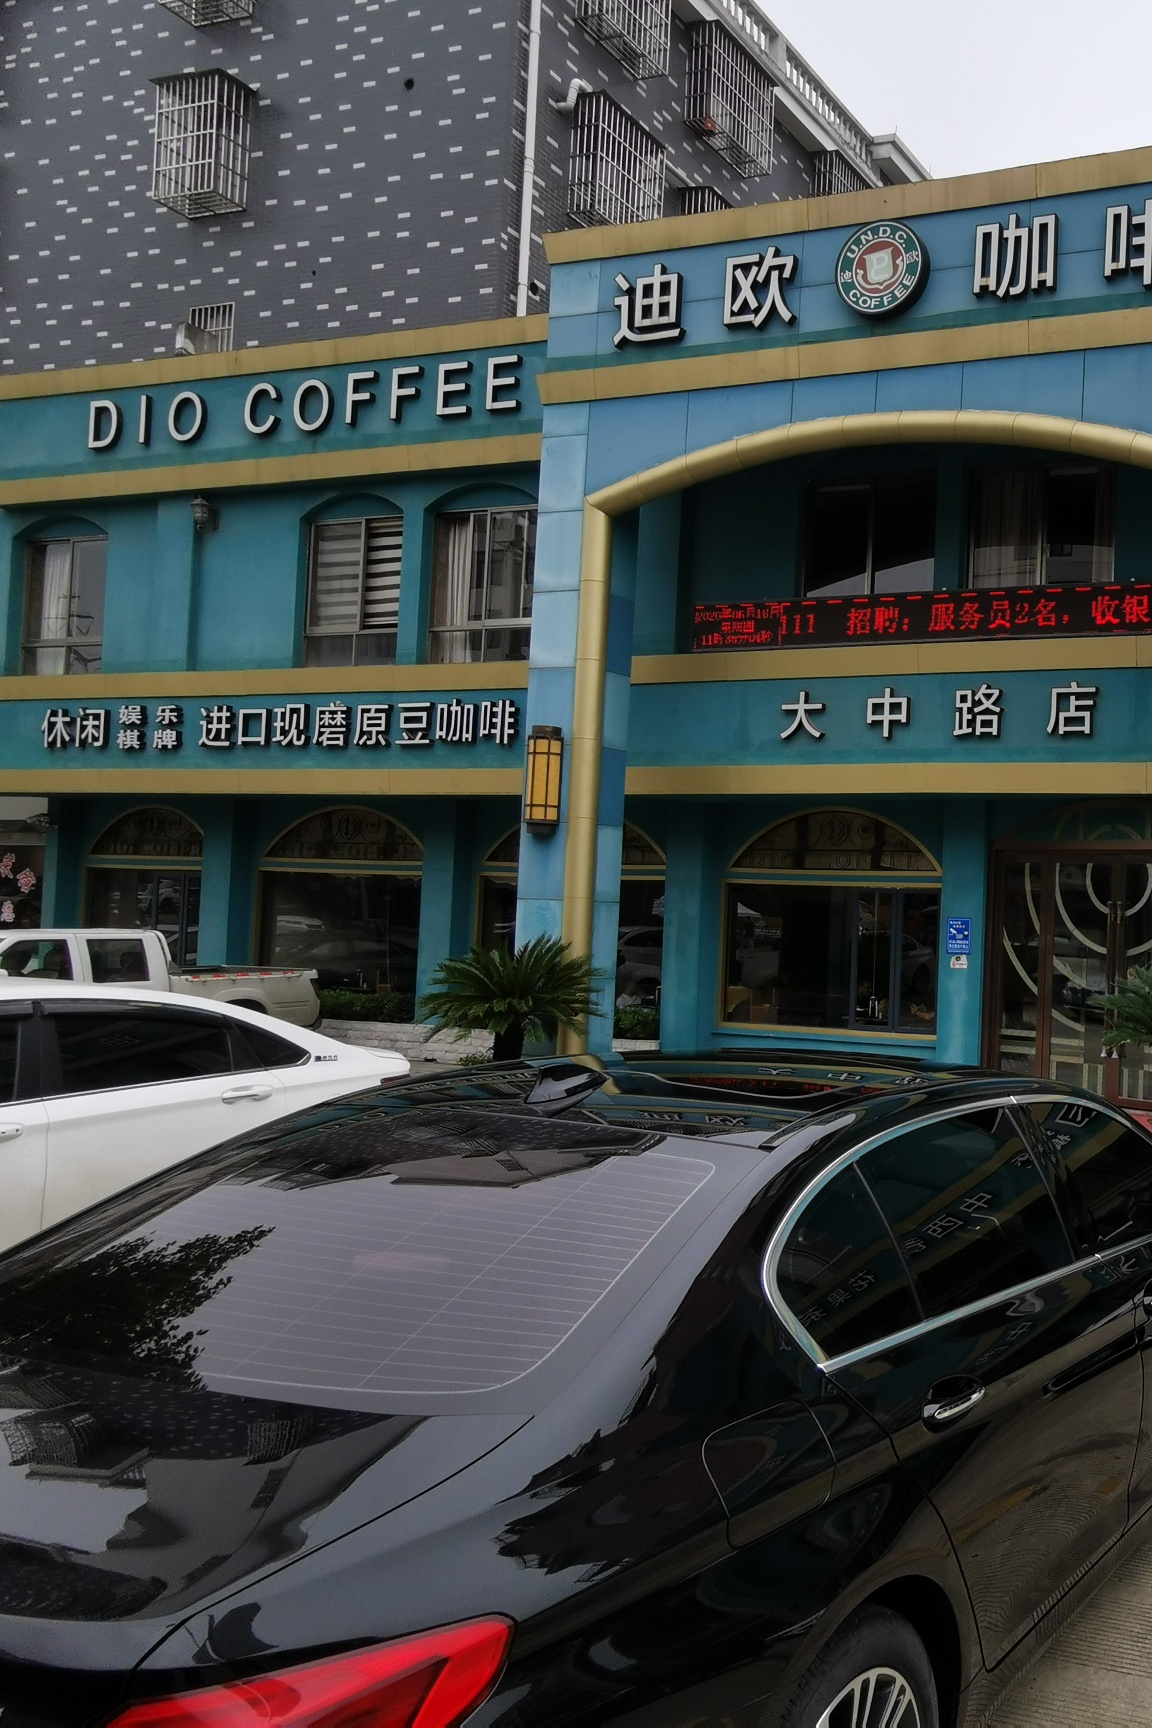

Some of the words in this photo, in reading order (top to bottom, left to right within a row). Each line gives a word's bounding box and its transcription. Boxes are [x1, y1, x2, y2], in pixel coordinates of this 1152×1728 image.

[847, 226, 907, 258] U.N.D.C.
[613, 247, 797, 349] 迪欧
[849, 273, 915, 309] COFFEE
[88, 391, 206, 449] DIO
[243, 354, 522, 434] COFFEE
[41, 705, 105, 748] 休闲
[118, 703, 182, 725] 娱乐
[198, 697, 519, 748] 进口现磨原豆咖啡
[779, 680, 1098, 740] 大中路店
[117, 728, 181, 750] 棋牌
